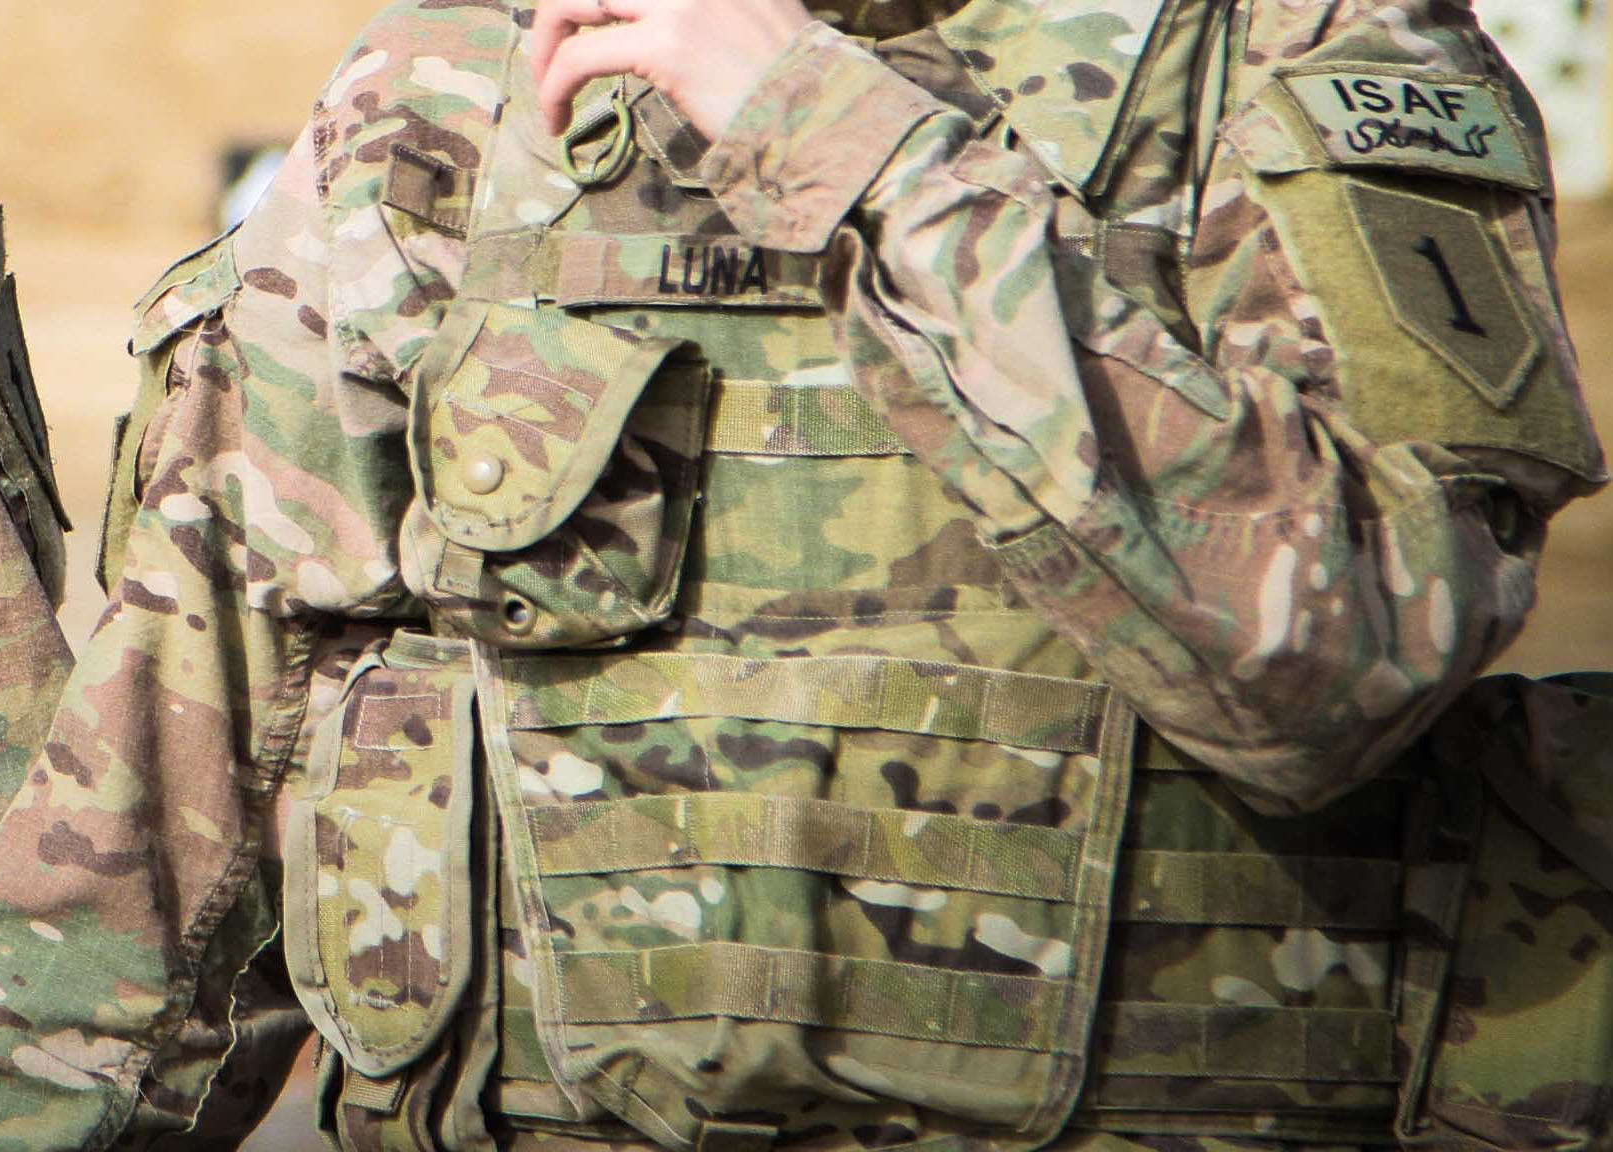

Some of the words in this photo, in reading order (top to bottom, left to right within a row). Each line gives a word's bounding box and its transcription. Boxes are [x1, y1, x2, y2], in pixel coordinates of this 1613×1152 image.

[1330, 78, 1466, 122] ISAF
[657, 244, 768, 294] LUNA
[1410, 234, 1488, 337] 1
